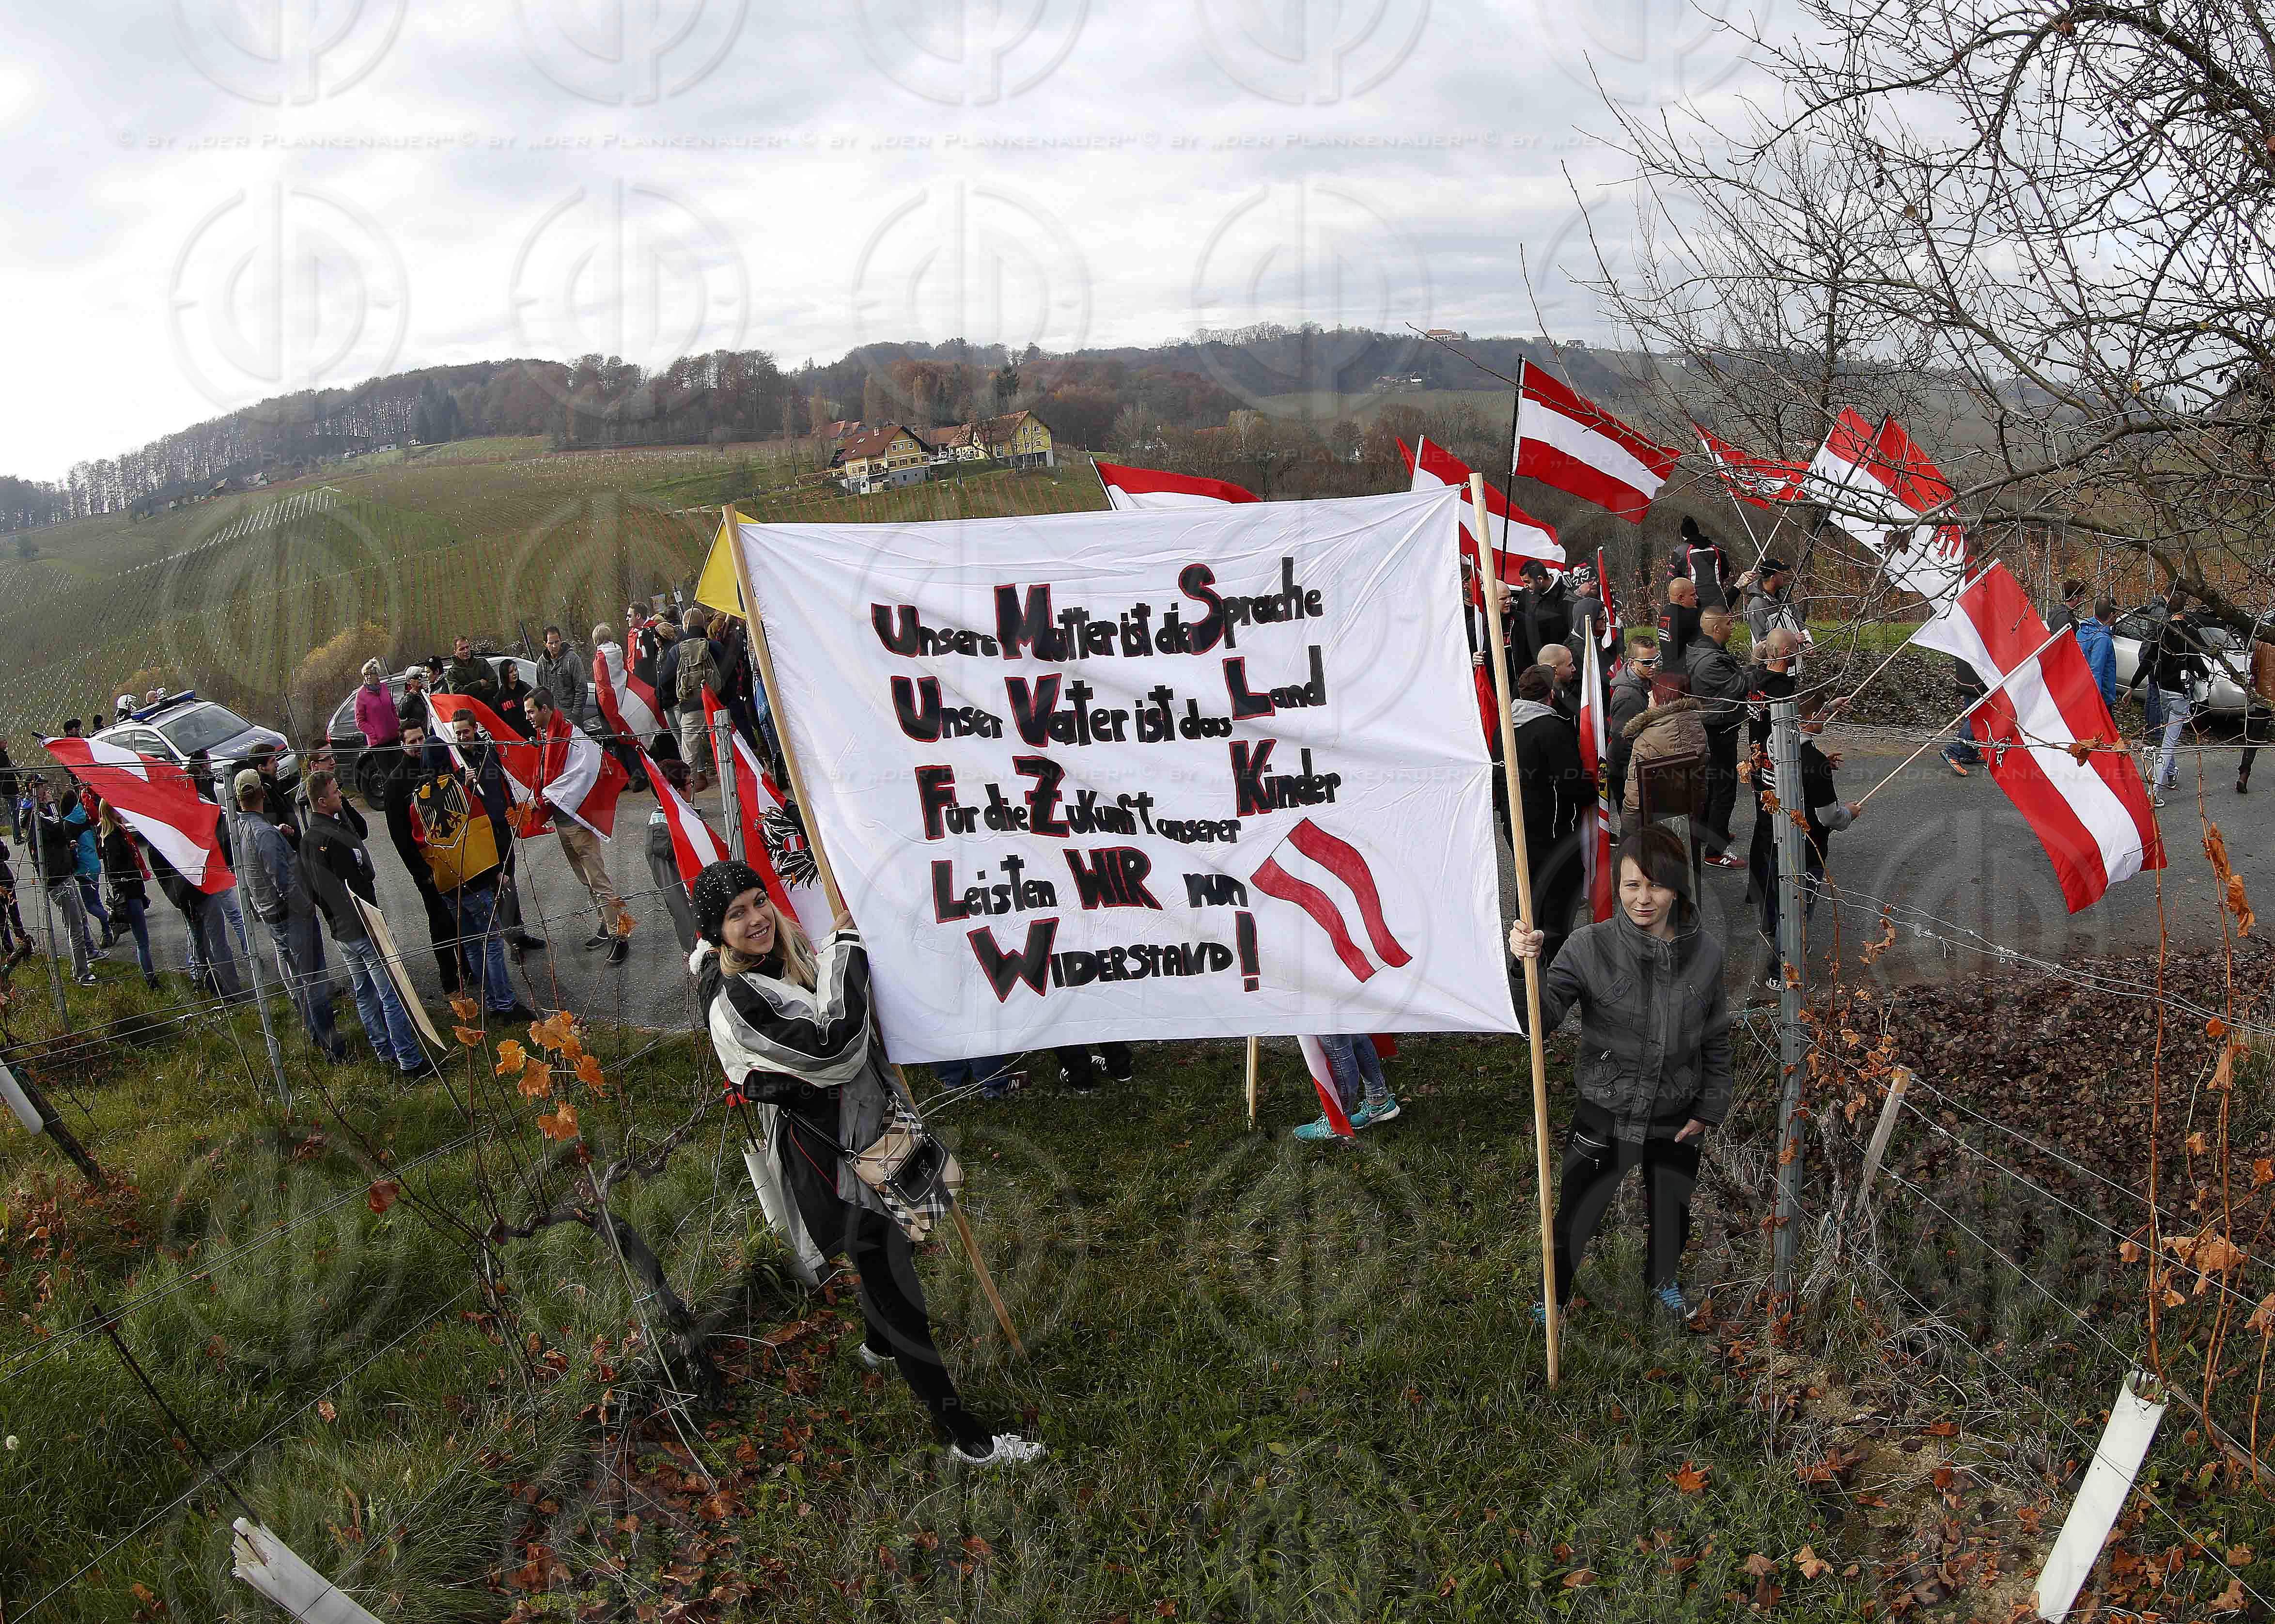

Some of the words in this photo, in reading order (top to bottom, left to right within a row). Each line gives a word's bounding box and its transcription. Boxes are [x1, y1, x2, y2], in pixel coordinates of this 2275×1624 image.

[871, 603, 999, 657] Unsere
[1121, 603, 1153, 657] ist
[1155, 602, 1194, 655] die
[1178, 557, 1323, 656] Sprache
[232, 735, 267, 753] POLIZEI
[890, 675, 1003, 743] Unser
[1004, 672, 1129, 747] Vater
[1135, 685, 1176, 743] ist
[1179, 698, 1233, 740] das
[1222, 645, 1327, 720] Land
[915, 765, 980, 840] Für
[984, 783, 1029, 832] die
[1156, 819, 1241, 844] unserer
[1228, 739, 1341, 817] Kinder
[932, 855, 1058, 924] Leisten
[1062, 846, 1163, 911] WIR
[1182, 874, 1248, 908] nun
